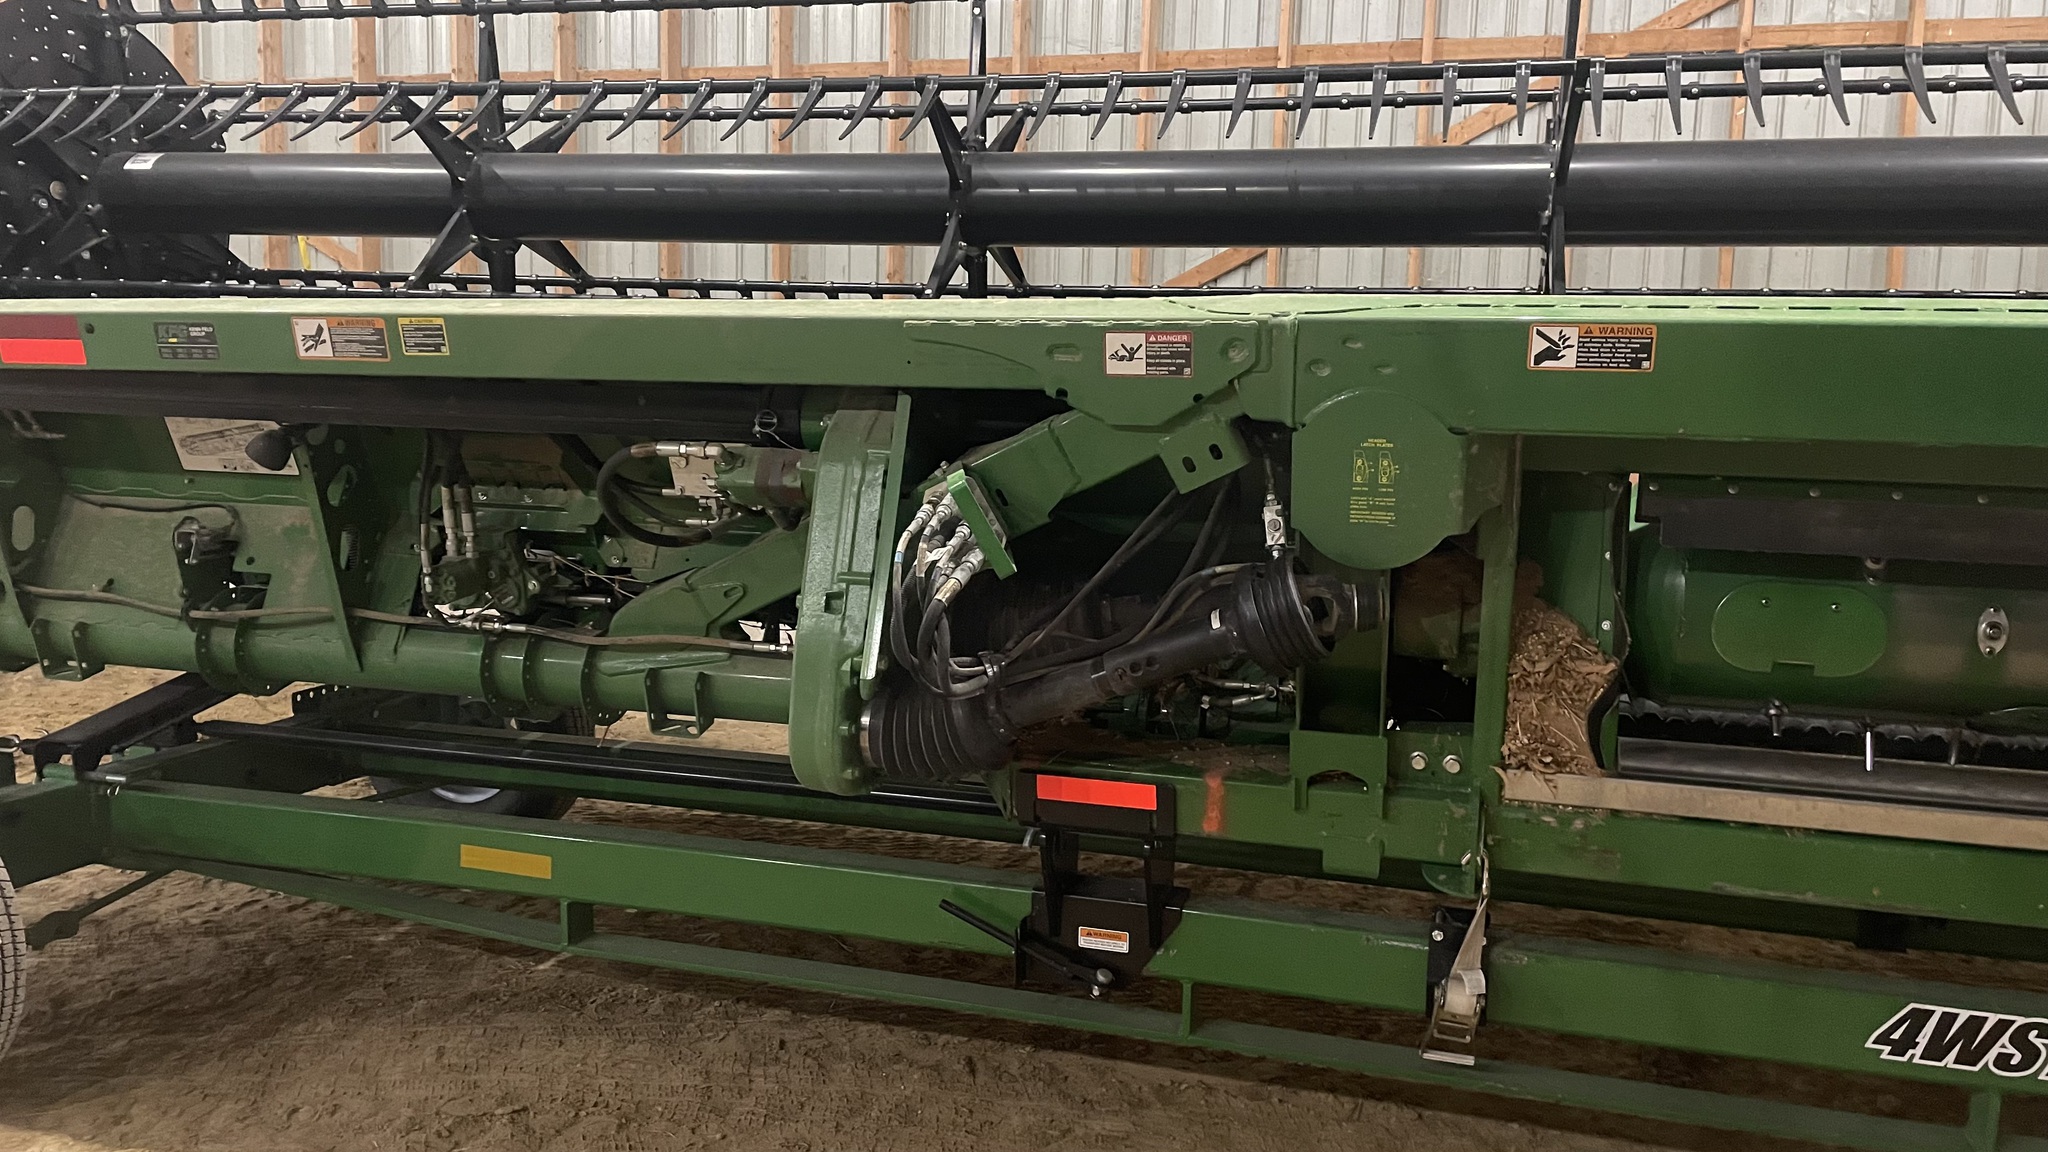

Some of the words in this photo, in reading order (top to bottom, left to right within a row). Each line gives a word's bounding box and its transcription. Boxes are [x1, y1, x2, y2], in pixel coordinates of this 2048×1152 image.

[344, 319, 376, 327] WARNING
[1598, 327, 1653, 336] WARNING
[1157, 334, 1188, 342] DANGER
[1093, 931, 1122, 940] WARNING
[1864, 1002, 2048, 1081] 4WS
